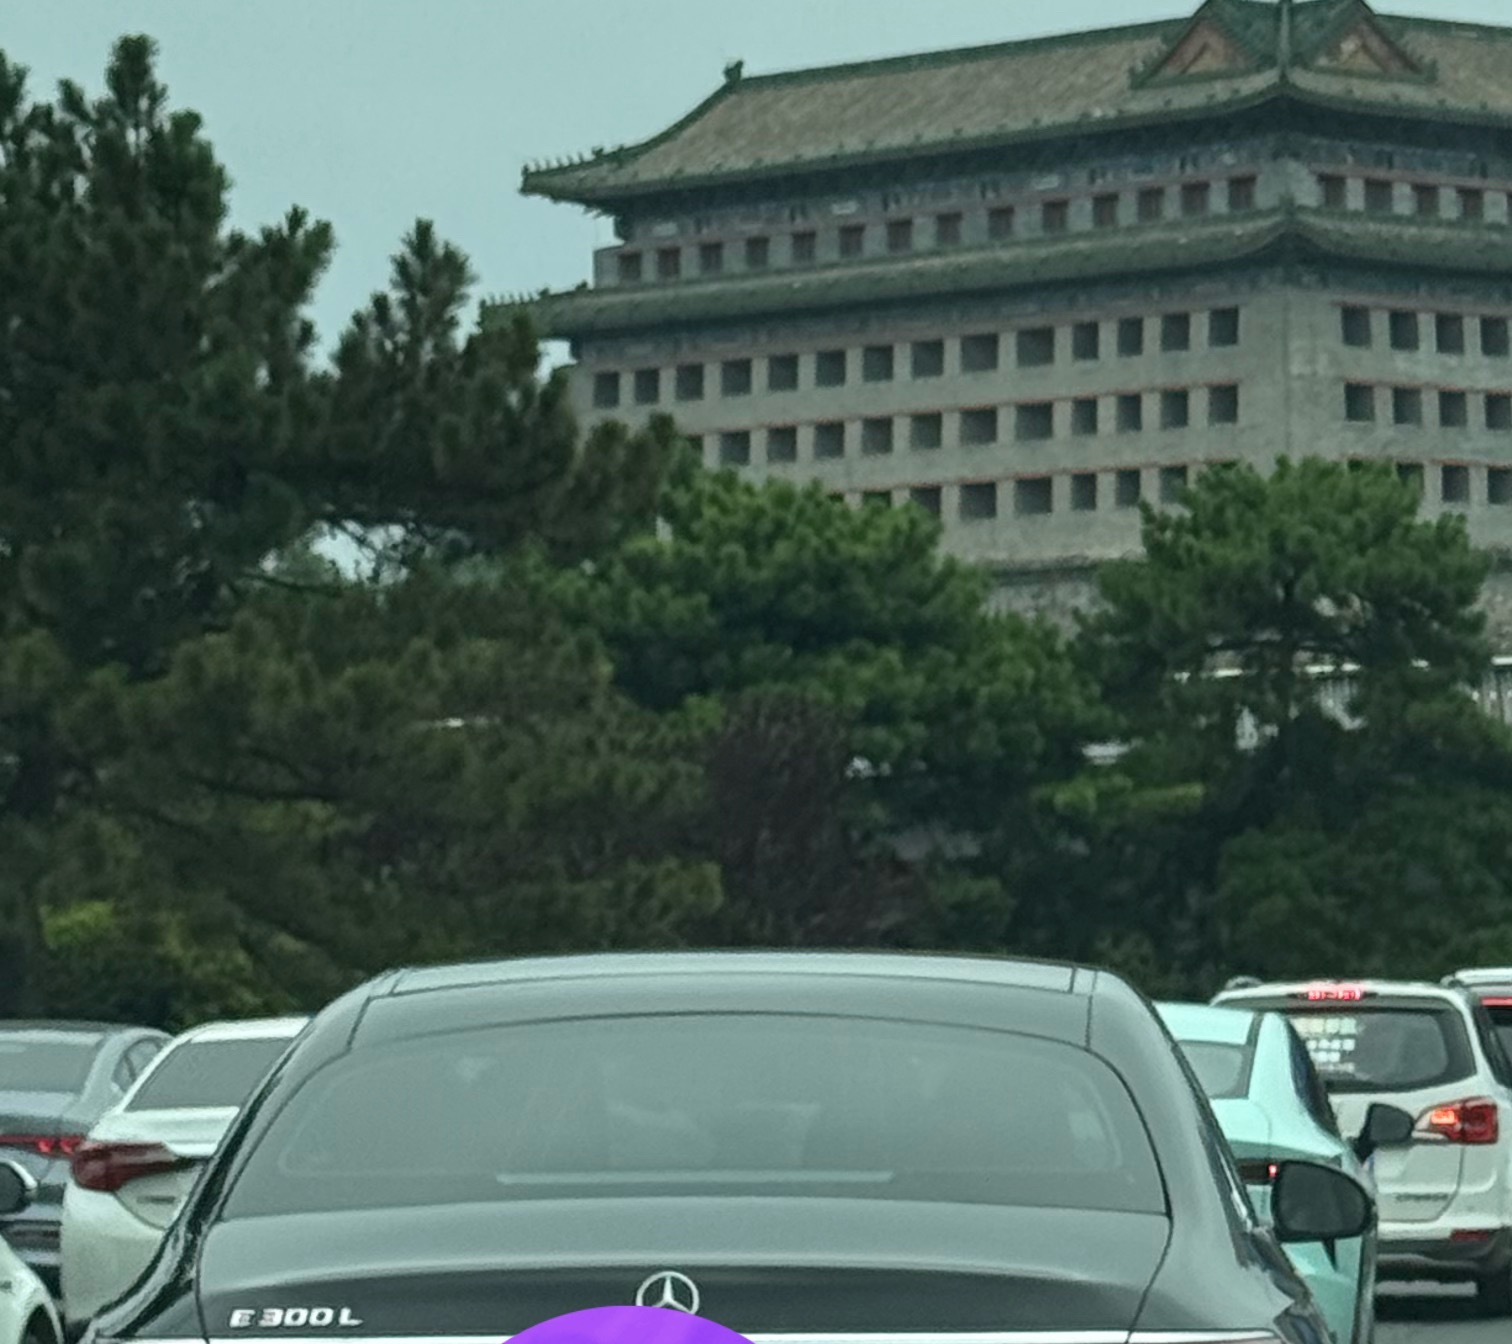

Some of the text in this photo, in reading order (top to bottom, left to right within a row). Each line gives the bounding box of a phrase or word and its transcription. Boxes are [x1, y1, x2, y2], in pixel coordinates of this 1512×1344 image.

[229, 1306, 364, 1328] E 300 L
